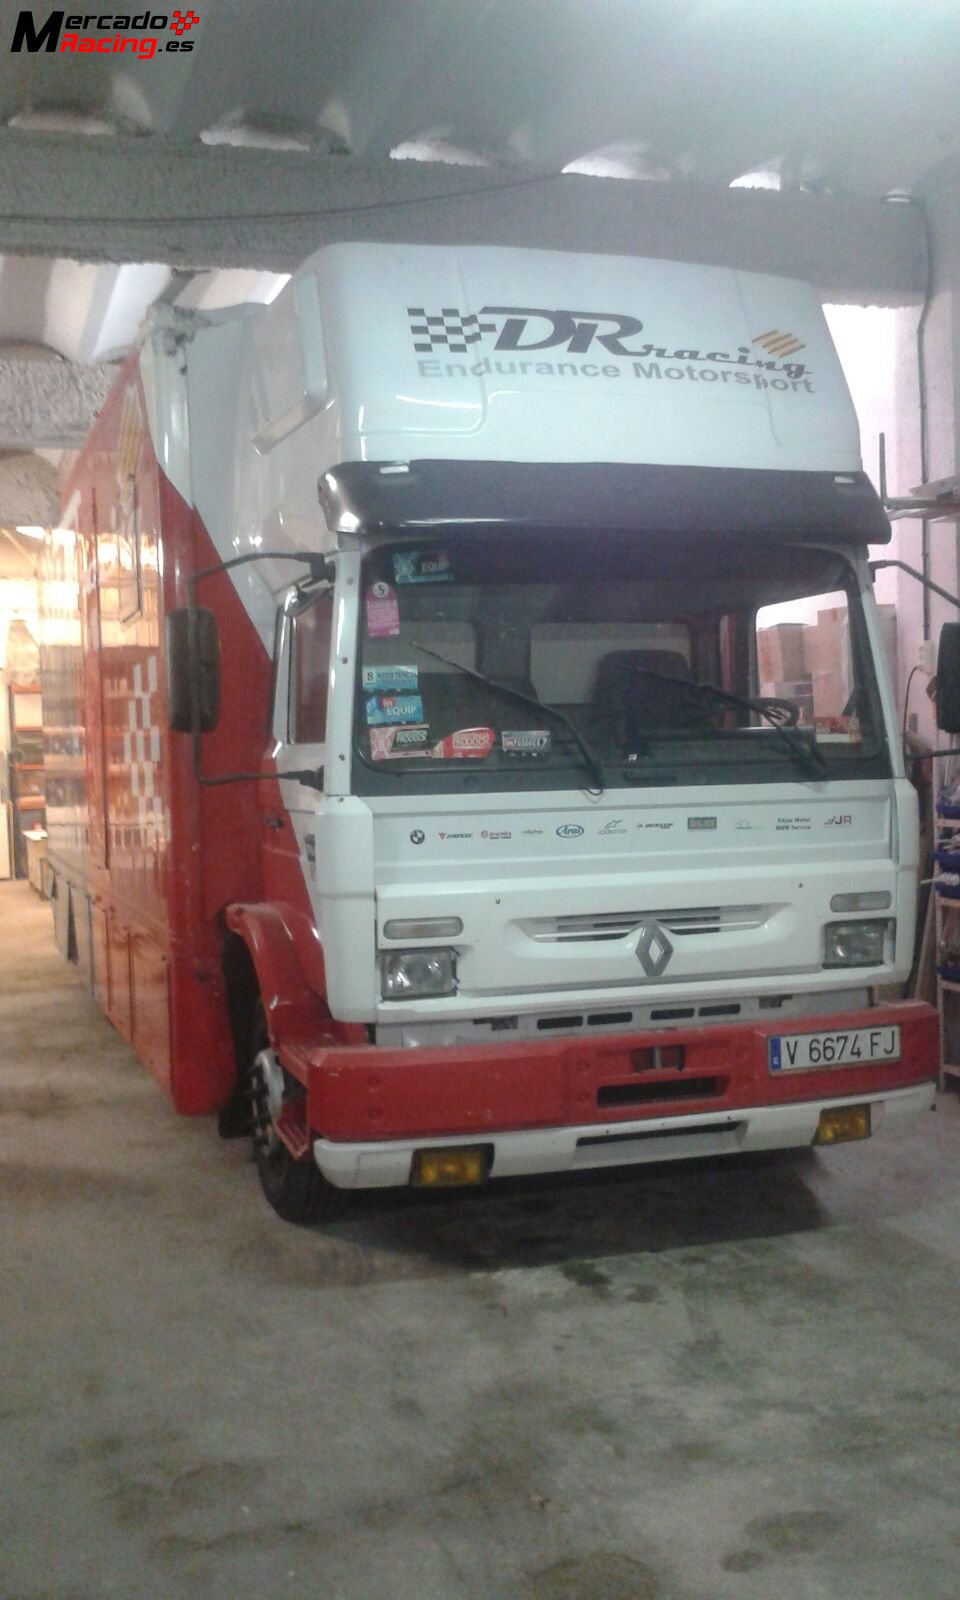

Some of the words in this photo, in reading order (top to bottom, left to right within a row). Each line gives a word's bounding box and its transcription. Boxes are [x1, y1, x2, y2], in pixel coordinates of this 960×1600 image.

[416, 357, 621, 378] Endurance
[632, 361, 816, 394] Motorsport
[387, 705, 417, 716] EQUIP
[786, 1040, 798, 1065] V
[808, 1033, 862, 1063] 6674
[869, 1030, 896, 1057] FJ
